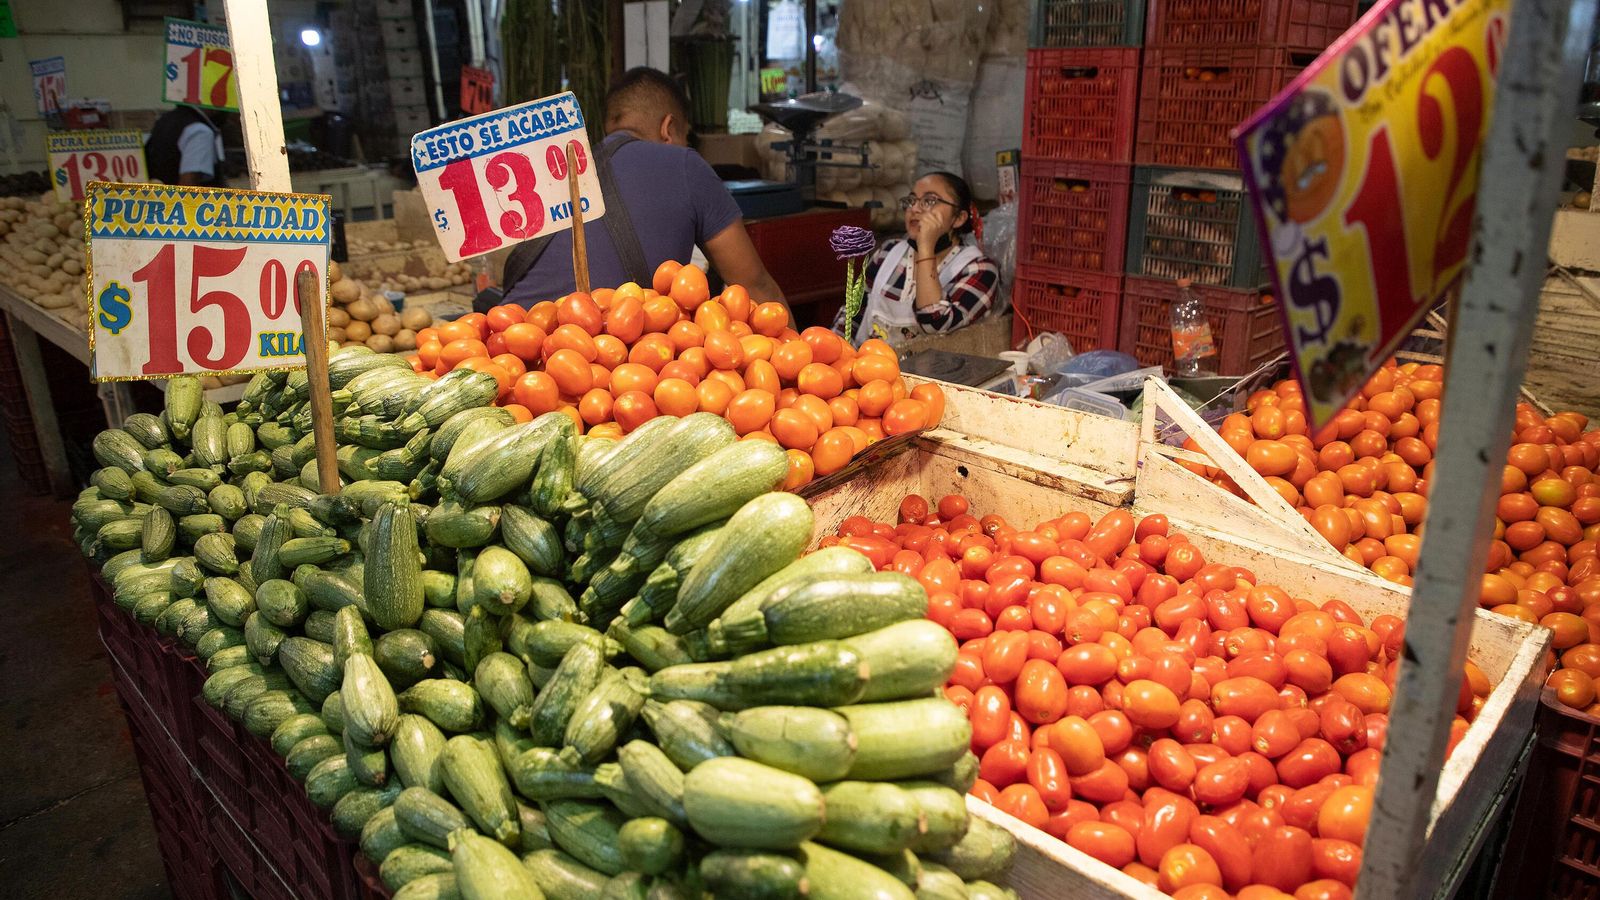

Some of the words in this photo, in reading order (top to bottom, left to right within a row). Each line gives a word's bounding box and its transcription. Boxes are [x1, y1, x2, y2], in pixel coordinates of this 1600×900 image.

[178, 29, 193, 40] NO
[197, 31, 230, 46] BUSQ
[1343, 0, 1464, 101] OFER
[52, 137, 84, 147] PURA
[87, 135, 137, 146] CALIDAD
[425, 135, 474, 160] ESTO
[480, 125, 502, 147] SE
[507, 108, 569, 139] ACABA
[101, 198, 187, 226] PURA
[196, 203, 320, 231] CALIDAD
